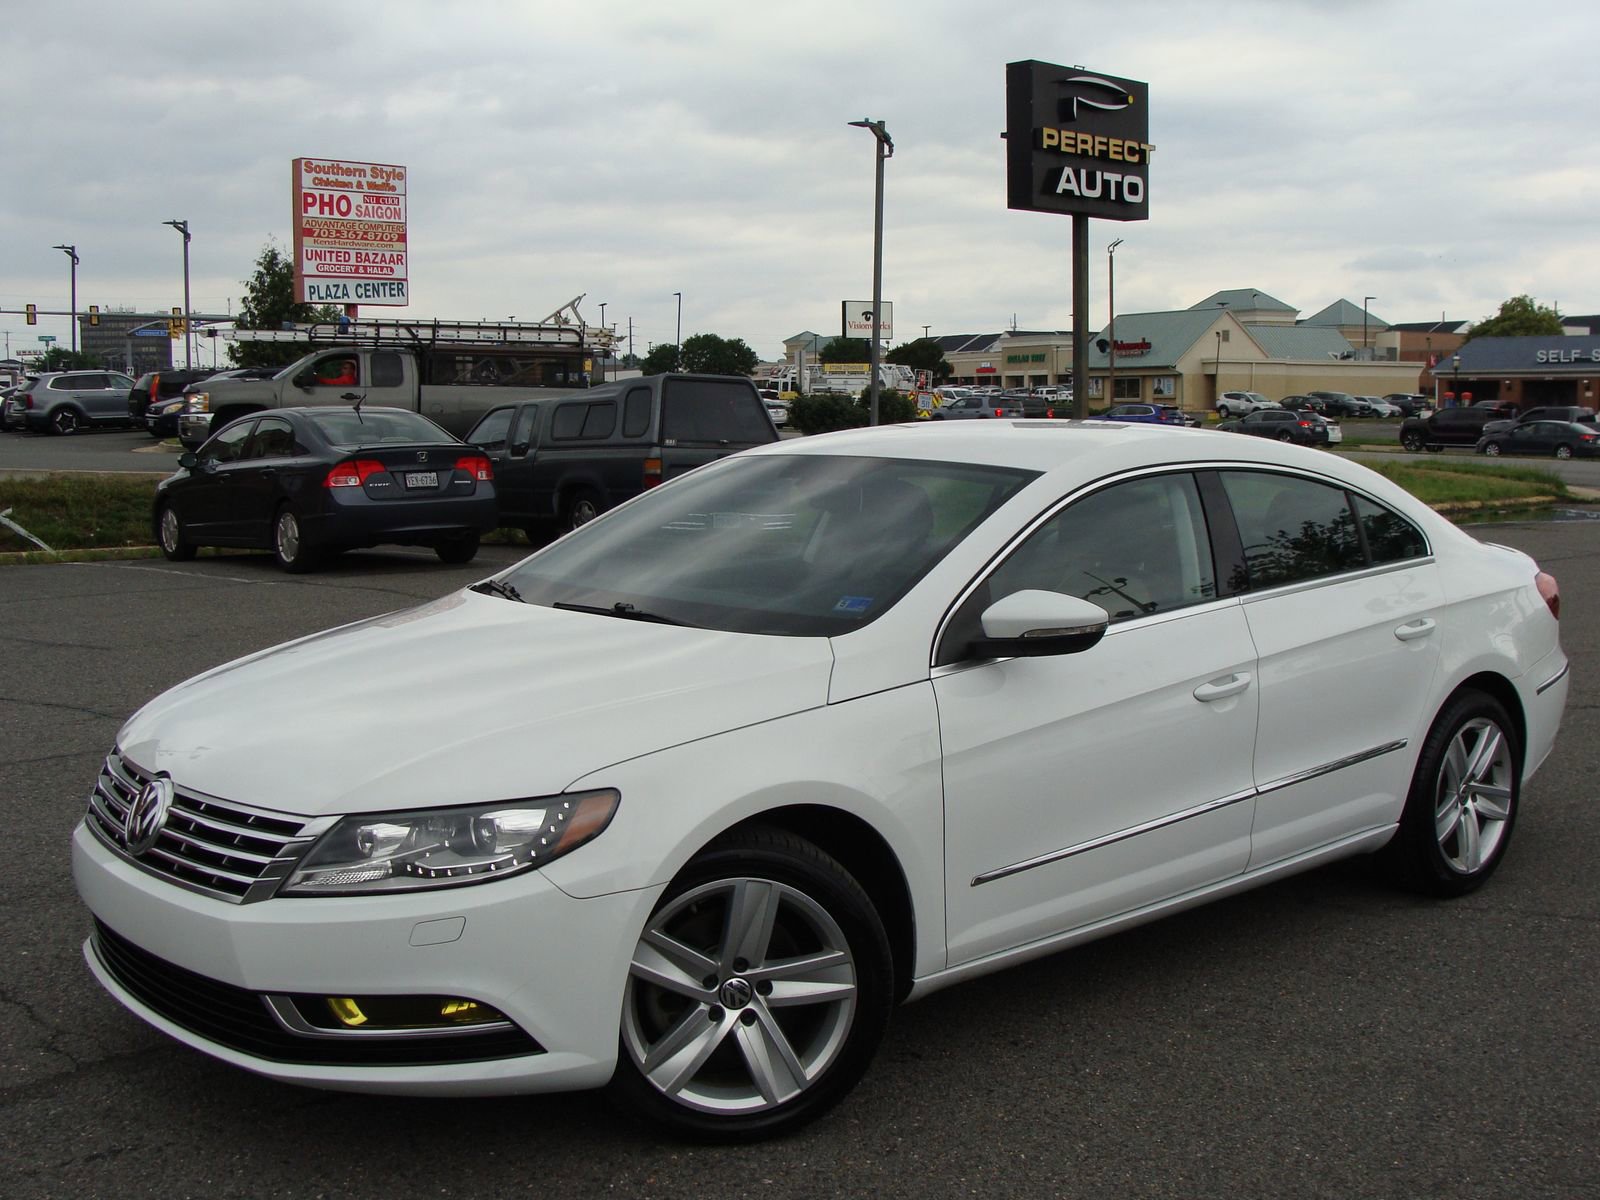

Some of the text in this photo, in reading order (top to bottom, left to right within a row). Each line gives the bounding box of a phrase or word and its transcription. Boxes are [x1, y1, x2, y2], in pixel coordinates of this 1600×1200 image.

[1042, 127, 1156, 165] PERFECT
[304, 160, 404, 182] Southern Style
[356, 180, 364, 190] &
[1056, 166, 1144, 203] AUTO
[303, 192, 352, 217] PHO
[355, 204, 401, 220] SAIGON
[304, 219, 405, 233] ADVANTAGE COMPUTERS
[313, 228, 399, 241] 703-367-8709
[313, 238, 394, 249] KensHardware.com
[305, 249, 404, 266] UNITED BAZAAR
[318, 264, 356, 273] GROCERY
[367, 266, 393, 275] HALAL
[308, 282, 405, 301] PLAZA CENTER
[848, 321, 891, 330] Visionrks
[1536, 349, 1581, 363] SELF
